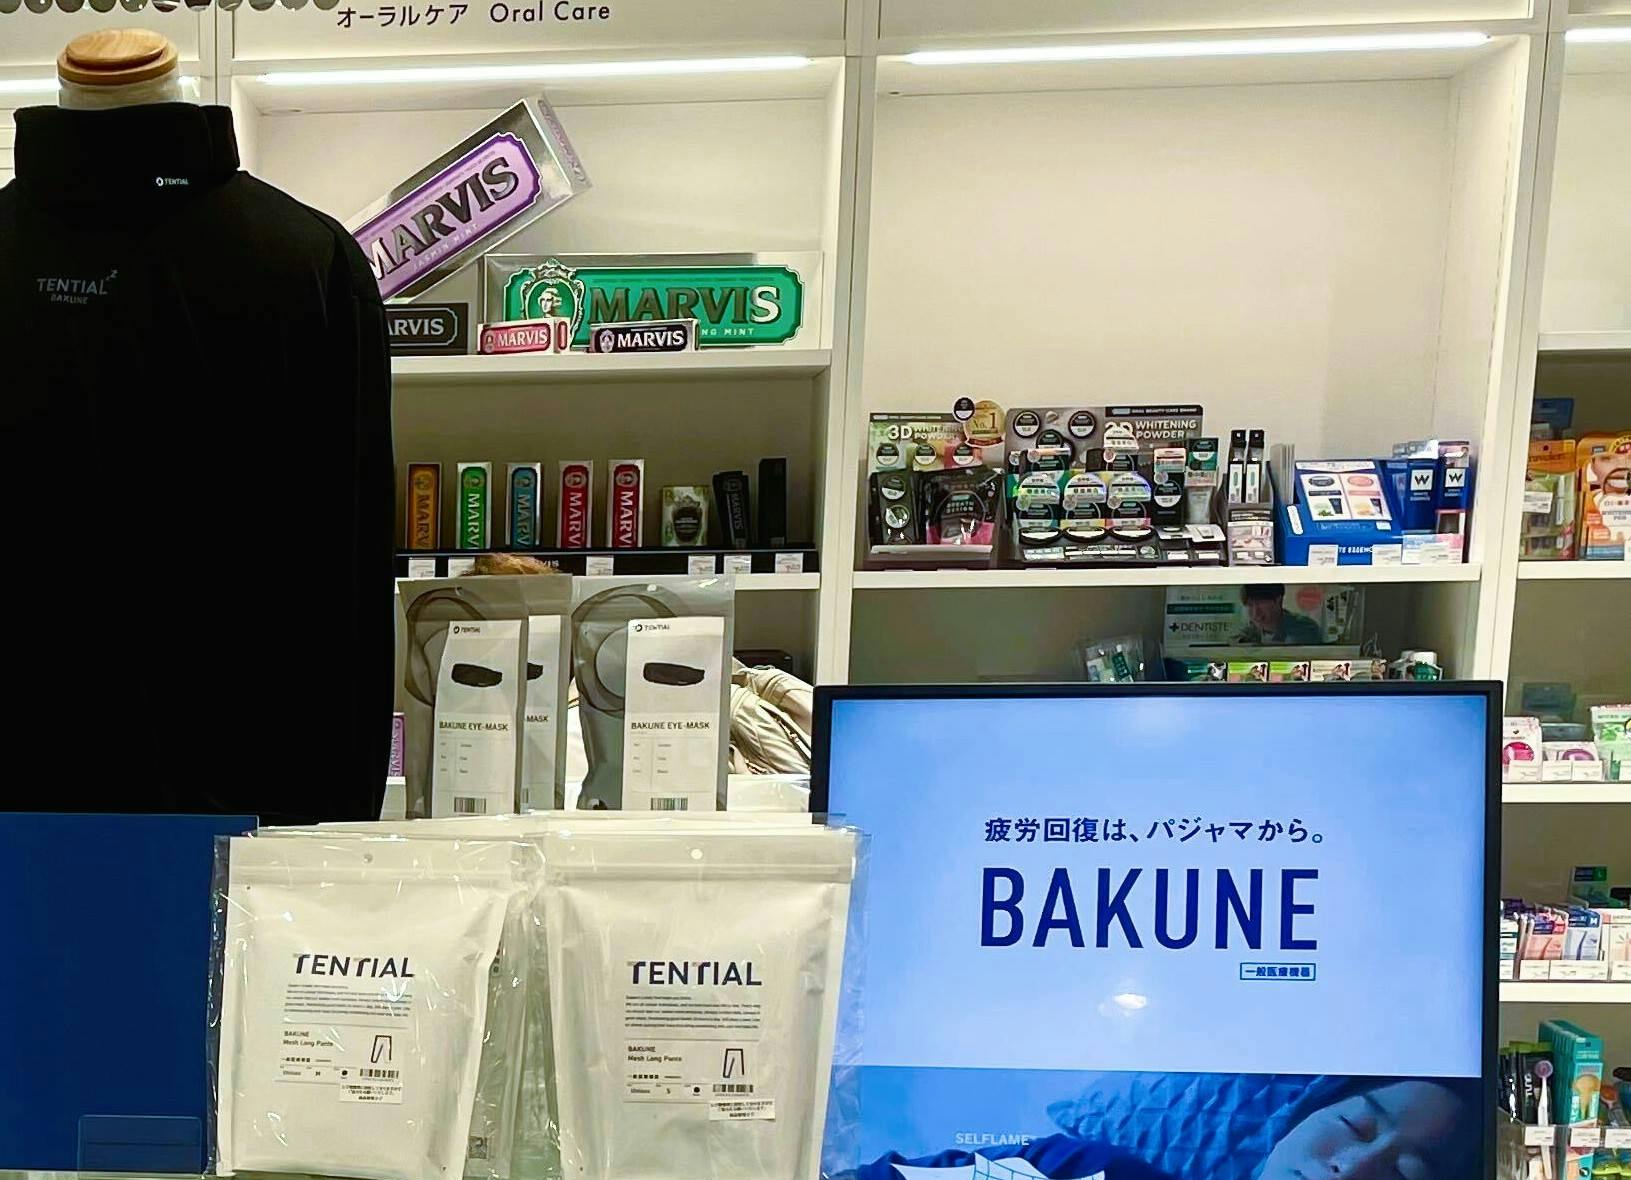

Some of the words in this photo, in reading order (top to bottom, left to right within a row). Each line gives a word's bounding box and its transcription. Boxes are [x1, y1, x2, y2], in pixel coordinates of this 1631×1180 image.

[337, 4, 468, 27] オーラルケア
[489, 1, 543, 23] Oral
[554, 1, 610, 20] Care
[370, 156, 518, 281] MARVIS
[37, 278, 108, 296] TENTIAL
[590, 286, 781, 324] MARVIS
[388, 317, 445, 337] ARVIS
[724, 328, 754, 336] MINT
[496, 329, 548, 347] MARVIS
[617, 330, 685, 348] MARVIS
[887, 424, 913, 440] 3D
[1135, 420, 1197, 430] WHITENING
[1135, 431, 1185, 439] POWDER
[439, 721, 466, 730] BAKUNE
[469, 722, 509, 732] EYE-MASK
[631, 721, 665, 730] BAKUNE
[667, 721, 710, 730] EYE-MASK
[984, 817, 1324, 843] 疲労回復は、パジャマから。
[980, 867, 1319, 951] BAKUNE
[293, 953, 415, 978] TENTIAL
[627, 960, 763, 986] TENTIAL
[955, 1132, 1030, 1146] SELFLAME
